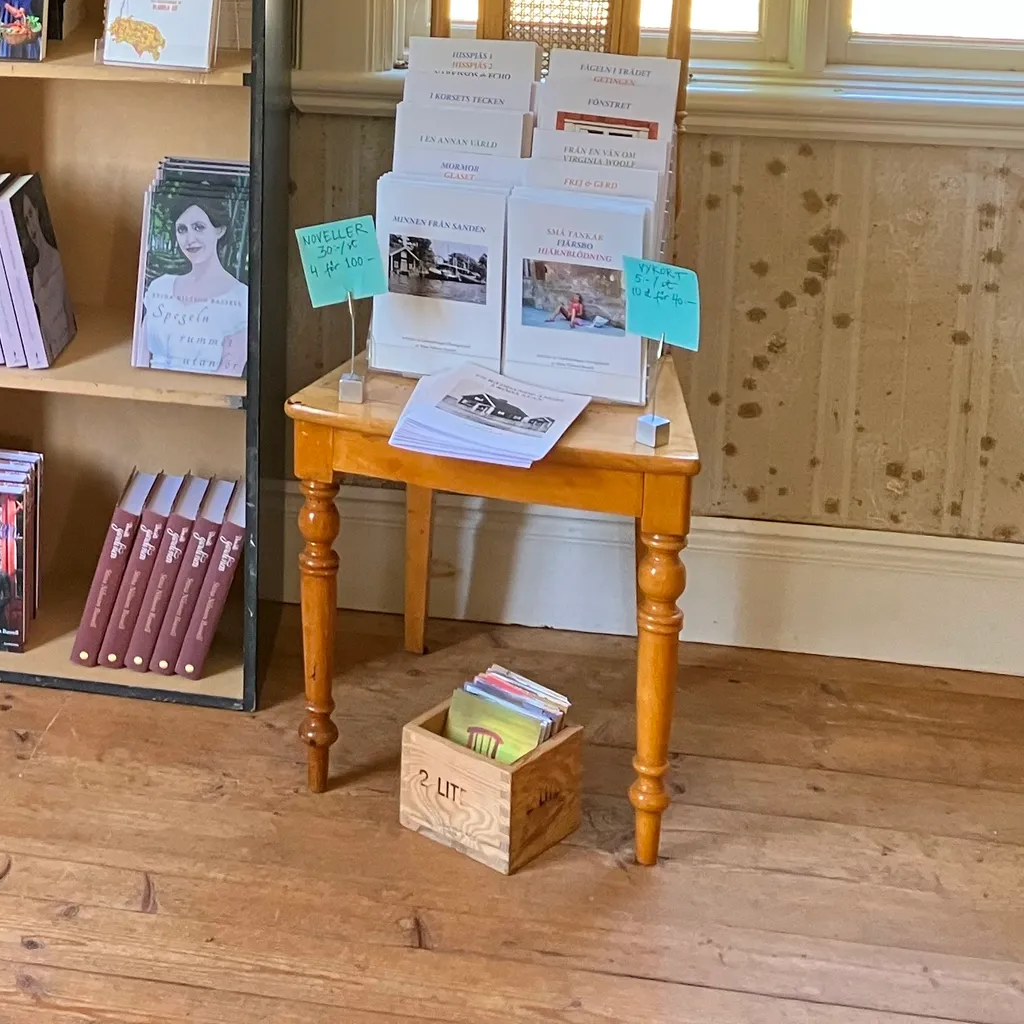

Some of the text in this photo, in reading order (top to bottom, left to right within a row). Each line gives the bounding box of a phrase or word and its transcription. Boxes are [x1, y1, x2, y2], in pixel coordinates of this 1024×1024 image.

[452, 51, 488, 60] HISSPJÄS
[452, 60, 488, 70] HISSPJÄS
[618, 68, 652, 78] TRÄDET
[434, 92, 471, 103] KORSETS
[472, 96, 506, 105] TECKEN
[588, 98, 632, 110] FÖNSTRET
[424, 135, 437, 144] EN
[437, 137, 469, 147] ANNAN
[441, 161, 480, 172] MORMOR
[392, 215, 487, 233] MINNEN FRÅN SANDEN
[302, 222, 369, 246] NOVELLER
[538, 247, 613, 263] HJÄRNBLÖDNING
[310, 264, 319, 278] 4
[324, 260, 341, 279] för
[152, 303, 209, 326] Spegeln
[419, 769, 429, 787] 2
